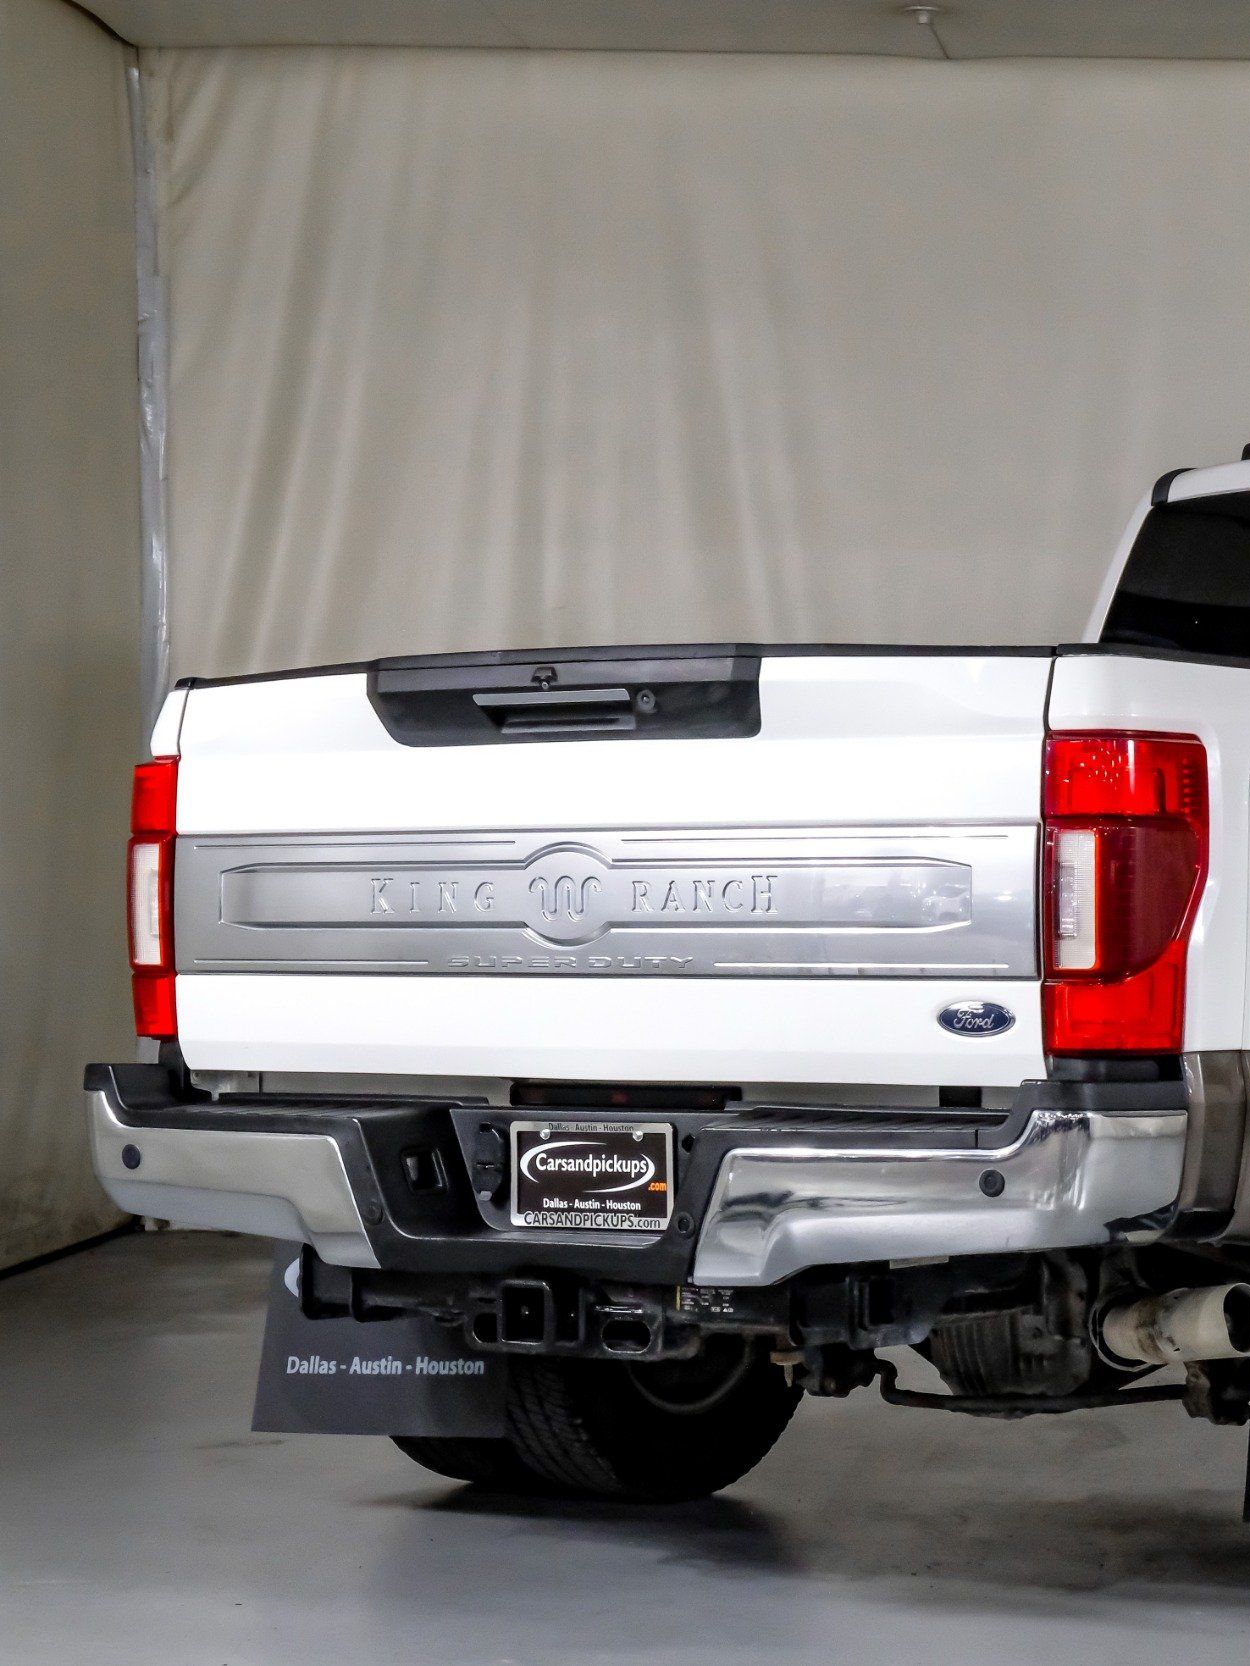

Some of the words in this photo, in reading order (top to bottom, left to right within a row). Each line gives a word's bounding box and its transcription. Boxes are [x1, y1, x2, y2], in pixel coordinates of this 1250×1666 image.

[370, 878, 495, 914] KING
[631, 875, 778, 915] RANCH
[448, 955, 577, 968] SUPER
[588, 956, 694, 969] DUTY
[953, 1009, 995, 1029] Ford
[548, 1122, 570, 1132] Dallas
[575, 1123, 598, 1132] Austin
[603, 1124, 635, 1133] Houston
[535, 1153, 647, 1178] Carsandpickups
[648, 1182, 667, 1191] .com
[543, 1198, 567, 1209] Dallas
[574, 1199, 600, 1210] Austin
[606, 1200, 641, 1211] Houston
[286, 1355, 337, 1375] Dallas
[348, 1355, 402, 1375] Austin
[415, 1356, 485, 1376] Houston
